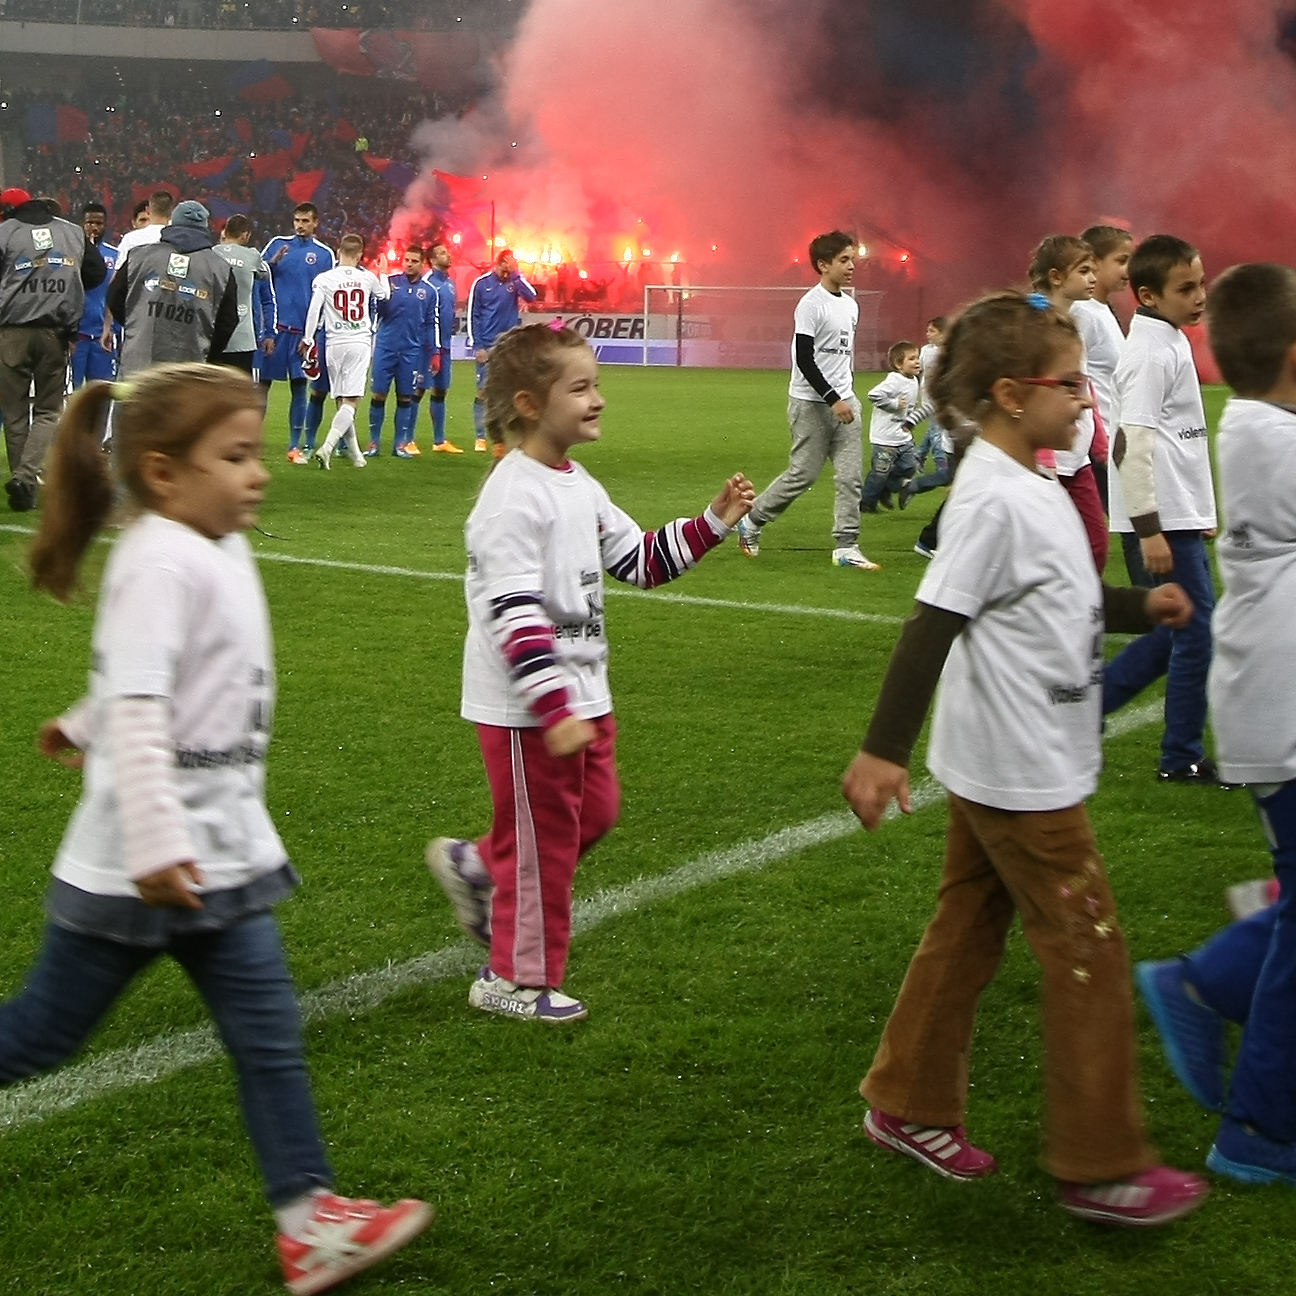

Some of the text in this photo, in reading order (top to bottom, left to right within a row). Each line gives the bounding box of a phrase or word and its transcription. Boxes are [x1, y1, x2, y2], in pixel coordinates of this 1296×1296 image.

[40, 278, 66, 294] 120
[147, 301, 195, 324] TV 026
[333, 289, 364, 321] 93
